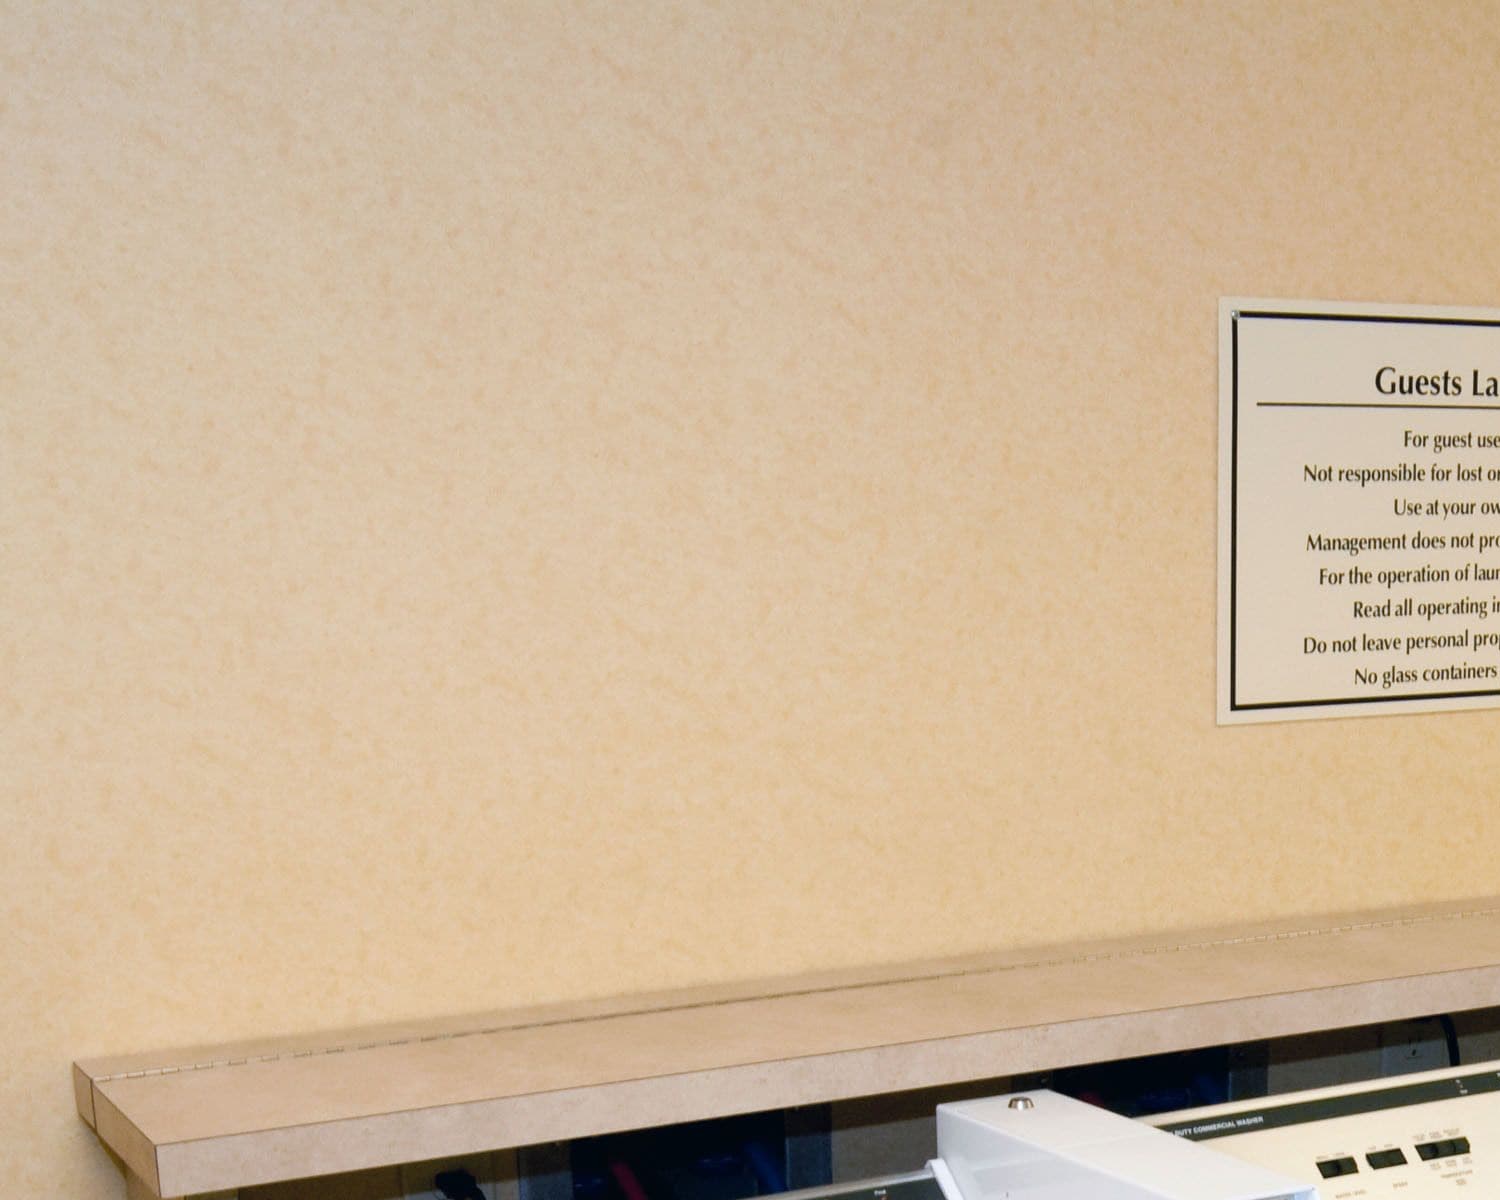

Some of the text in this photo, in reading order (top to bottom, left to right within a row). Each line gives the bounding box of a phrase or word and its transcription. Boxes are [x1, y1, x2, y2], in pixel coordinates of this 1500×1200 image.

[1375, 366, 1462, 396] Guests
[1404, 430, 1429, 448] For
[1433, 432, 1472, 453] guest
[1304, 465, 1333, 482] Not
[1338, 463, 1426, 488] responsible
[1431, 463, 1452, 482] for
[1457, 463, 1482, 482] lost
[1394, 499, 1422, 516] Use
[1426, 499, 1439, 516] at
[1442, 503, 1476, 520] your
[1306, 534, 1406, 556] Management
[1411, 530, 1446, 549] does
[1451, 532, 1474, 548] not
[1319, 568, 1345, 585] For
[1349, 566, 1373, 585] the
[1377, 564, 1450, 589] operation
[1454, 563, 1470, 581] of
[1353, 599, 1391, 618] Read
[1395, 598, 1413, 617] all
[1417, 596, 1488, 621] operating
[1304, 637, 1327, 654] Do
[1332, 636, 1357, 653] not
[1362, 633, 1401, 652] leave
[1406, 629, 1469, 655] personal
[1355, 668, 1378, 685] No
[1382, 665, 1418, 689] glass
[1422, 662, 1497, 682] containers
[1193, 1119, 1236, 1135] COMMERCIAL
[1236, 1115, 1264, 1127] WASHER
